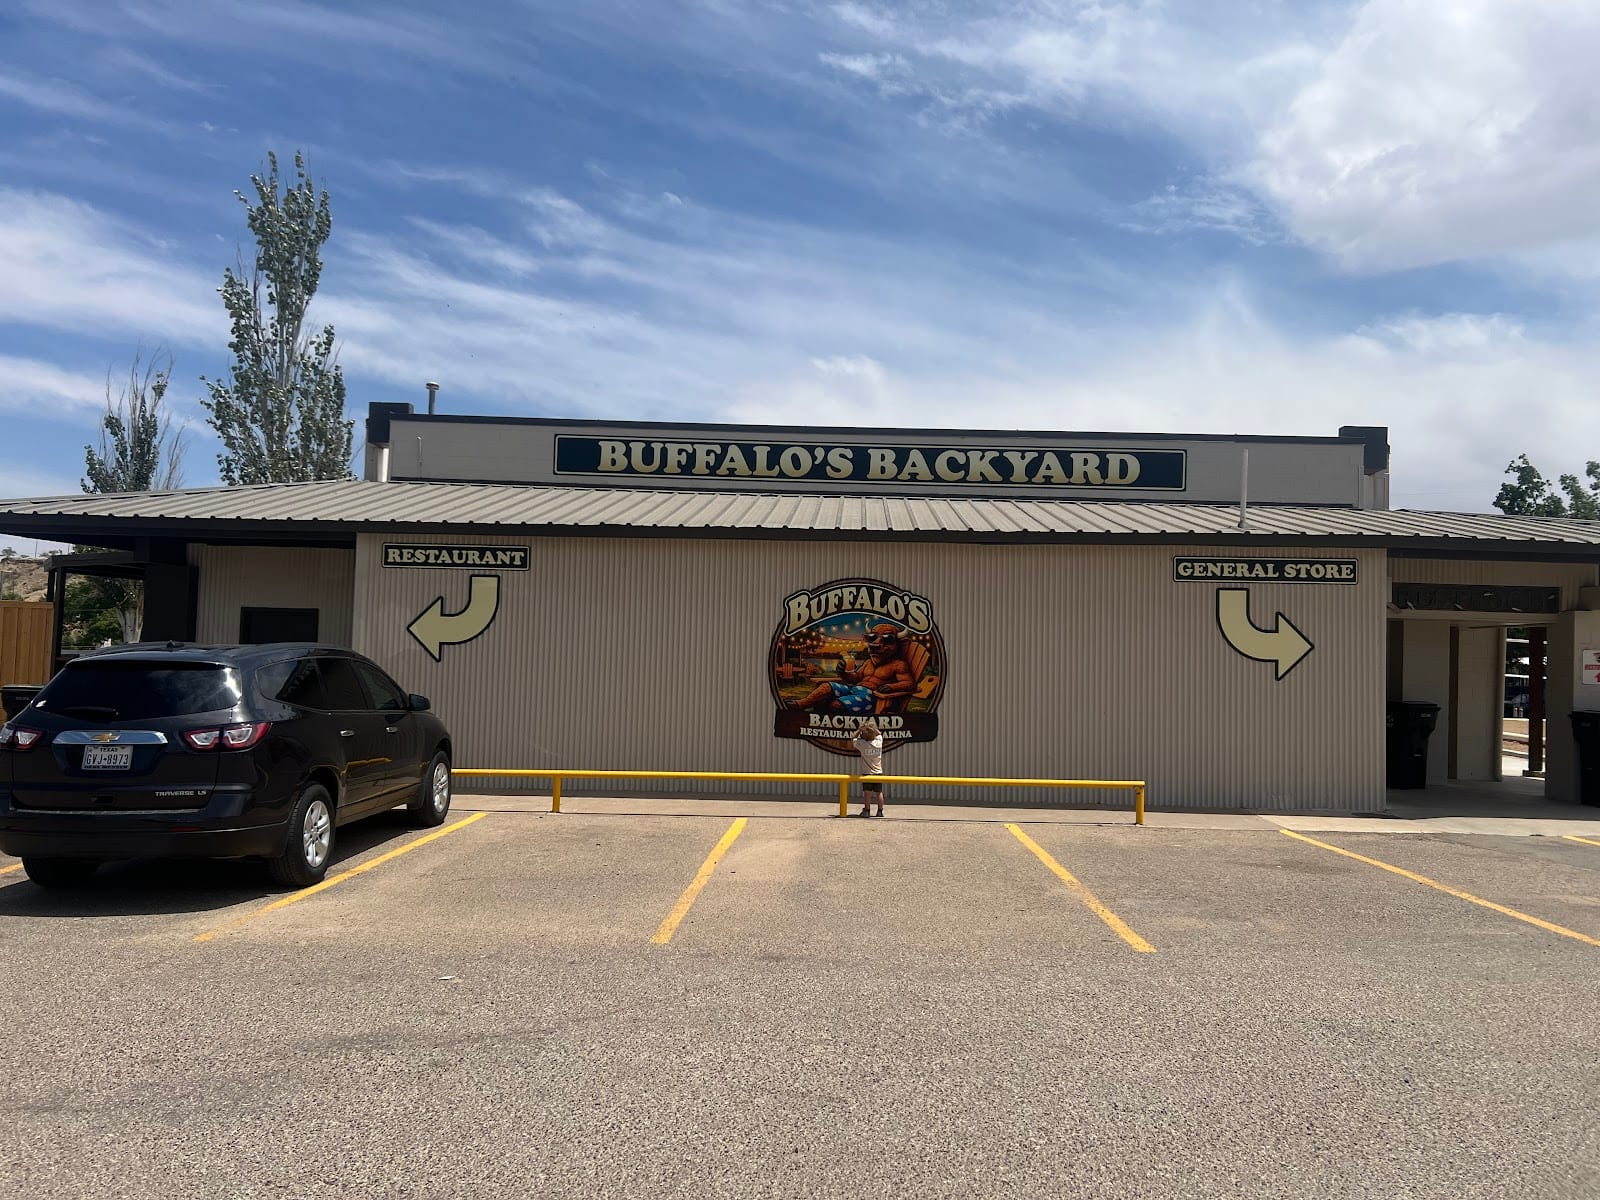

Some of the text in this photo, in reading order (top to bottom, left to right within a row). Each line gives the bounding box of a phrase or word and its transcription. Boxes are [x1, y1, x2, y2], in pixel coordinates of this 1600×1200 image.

[597, 440, 1141, 485] BUFFALO'S BACKYARD
[386, 548, 525, 566] RESTAURANT
[1177, 562, 1355, 580] GENERAL STORE
[788, 586, 930, 633] BUFFALO'S
[881, 730, 913, 740] ARINA
